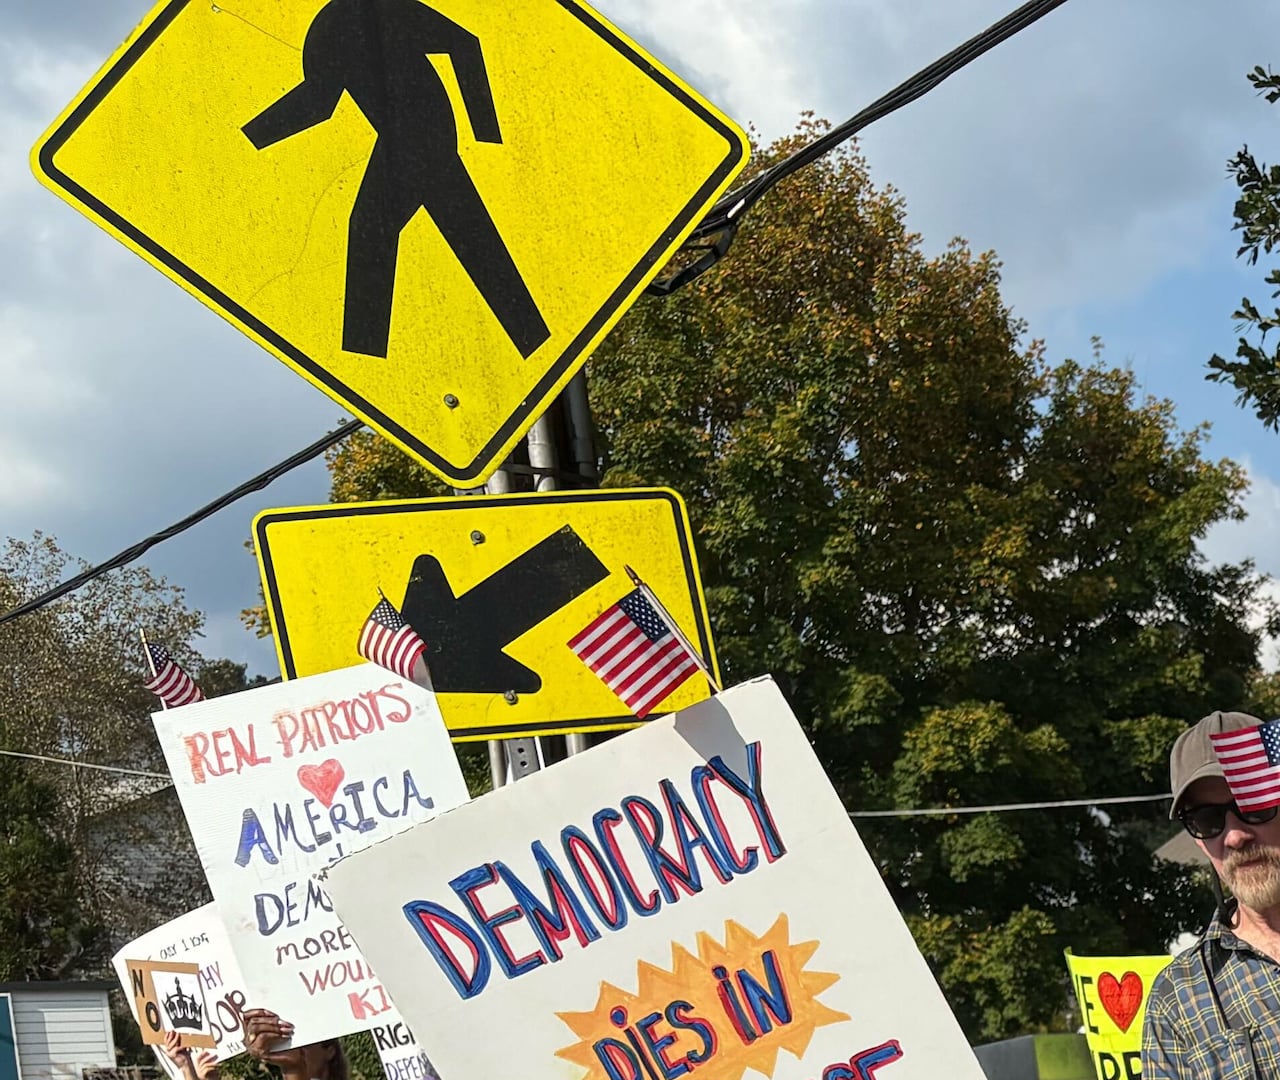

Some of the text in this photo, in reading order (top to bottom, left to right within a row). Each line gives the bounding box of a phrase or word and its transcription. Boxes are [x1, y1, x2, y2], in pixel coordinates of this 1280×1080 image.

[271, 683, 412, 758] PATRIOTS
[234, 769, 434, 868] AMERICA
[402, 740, 786, 1000] DEMOCRACY
